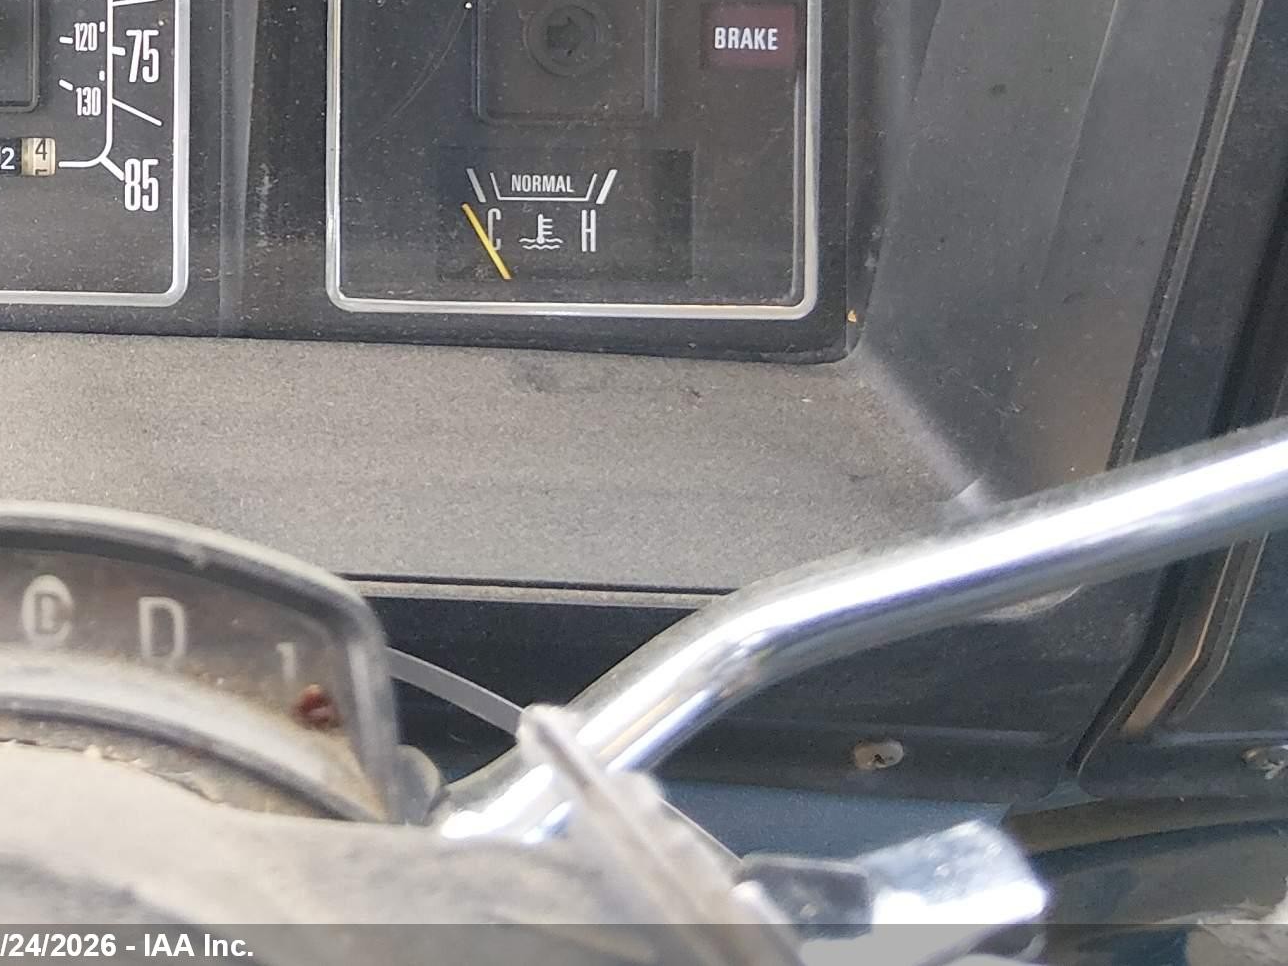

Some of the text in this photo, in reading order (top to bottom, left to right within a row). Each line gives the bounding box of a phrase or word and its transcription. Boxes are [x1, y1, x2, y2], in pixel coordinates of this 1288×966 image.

[74, 23, 97, 51] 120
[714, 27, 778, 50] BRAKE
[126, 30, 159, 82] 75
[76, 87, 101, 116] 130
[124, 158, 159, 211] 85
[512, 174, 575, 193] NORMAL
[487, 208, 596, 252] C H
[138, 596, 187, 662] D
